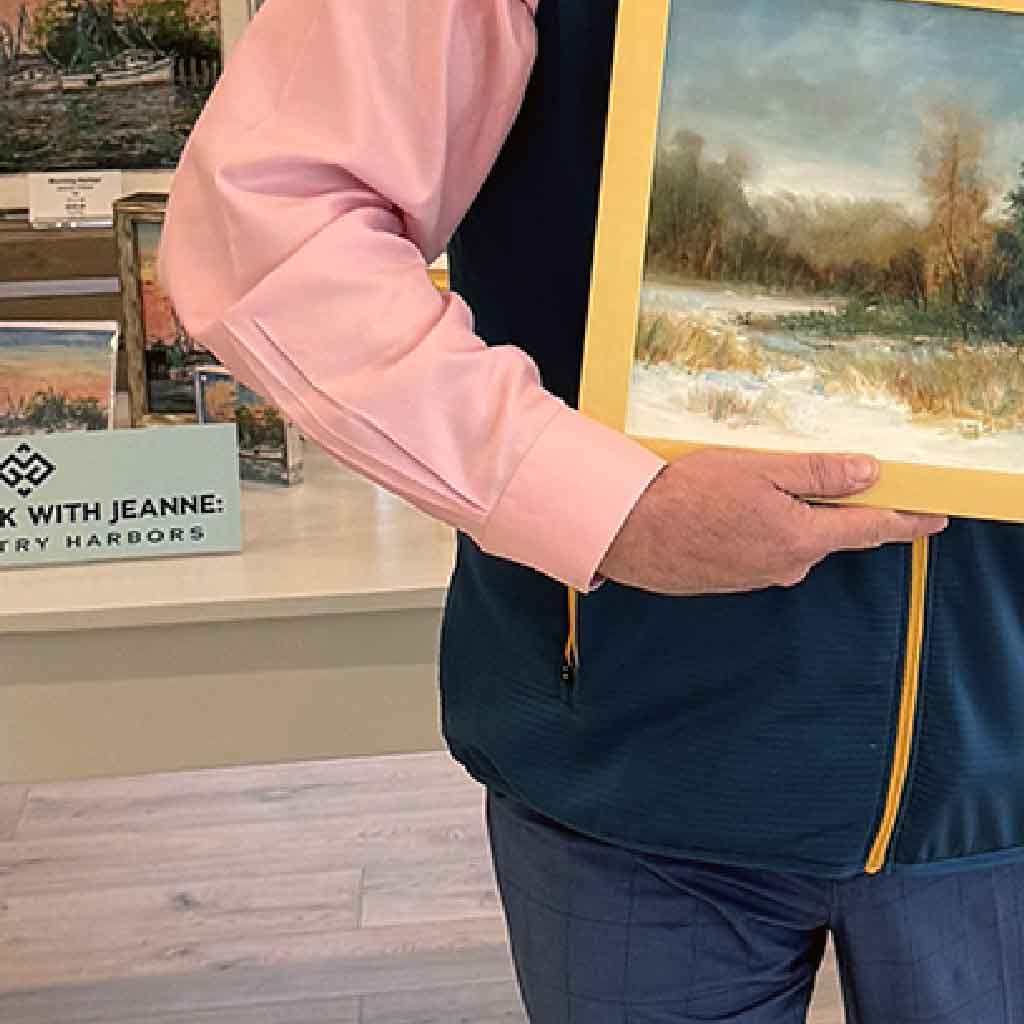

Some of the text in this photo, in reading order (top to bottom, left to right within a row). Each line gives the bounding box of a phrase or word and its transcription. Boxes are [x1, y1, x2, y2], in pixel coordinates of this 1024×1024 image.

[27, 502, 102, 526] WITH
[108, 494, 224, 525] JEANNE:
[65, 526, 204, 549] HARBORS
